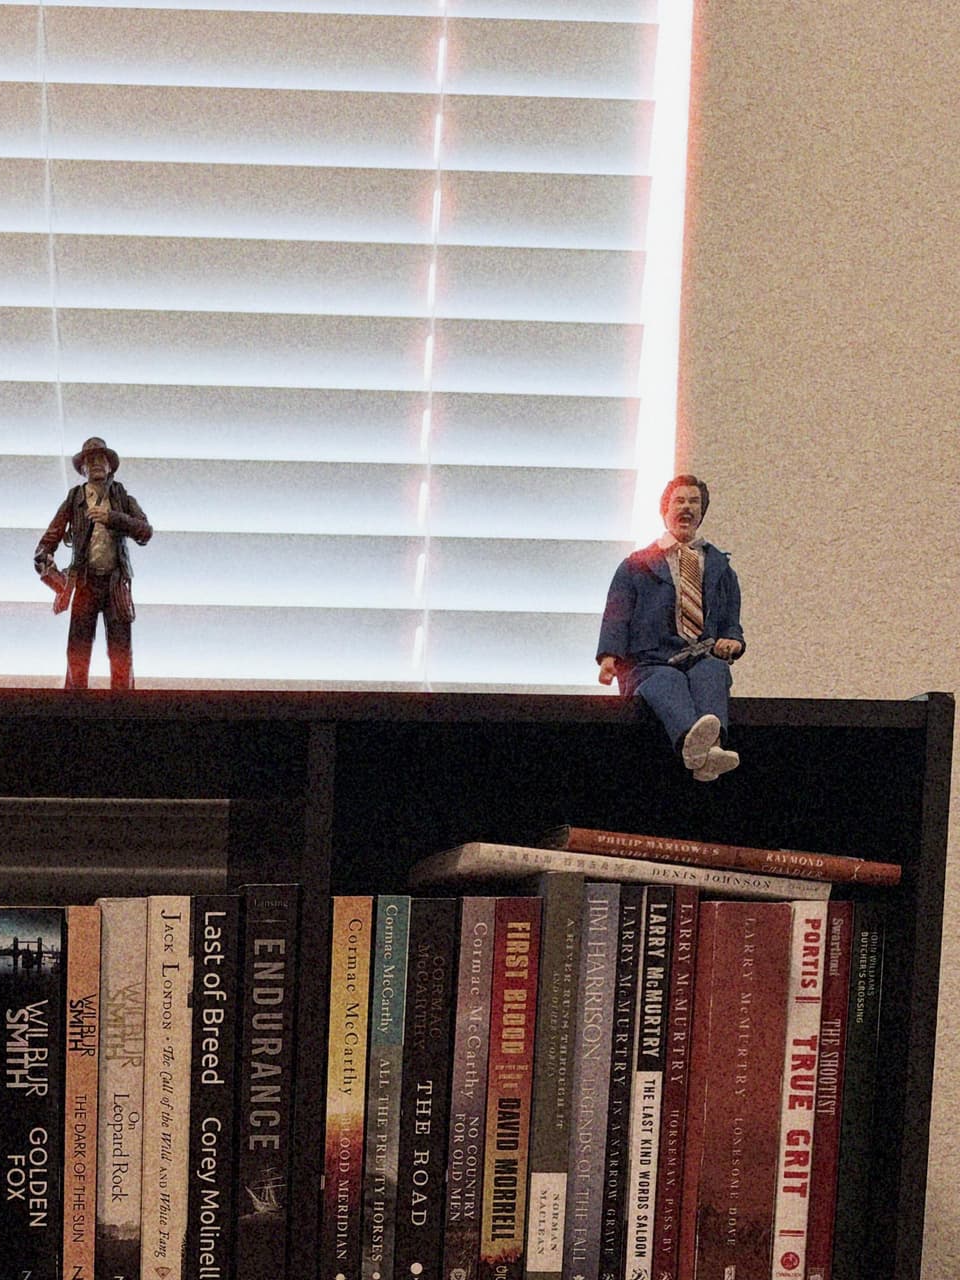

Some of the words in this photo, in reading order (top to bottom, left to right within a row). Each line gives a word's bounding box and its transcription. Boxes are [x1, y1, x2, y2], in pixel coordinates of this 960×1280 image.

[766, 854, 823, 868] RAYMOND
[204, 911, 226, 965] Last
[346, 919, 362, 992] Cormac
[505, 922, 530, 980] FIRST
[648, 904, 667, 959] LARRY
[802, 919, 821, 989] PORTIS
[203, 975, 226, 1001] of
[642, 967, 663, 1057] McMURTRY
[201, 1009, 225, 1084] Breed
[249, 938, 286, 1150] ENDURANCE
[339, 1003, 359, 1096] McCarthy
[502, 989, 527, 1053] BLOOD
[644, 1080, 656, 1100] THE
[789, 1035, 818, 1111] TRUE
[415, 1081, 433, 1135] THE
[497, 1099, 520, 1150] DAVID
[643, 1106, 653, 1133] LAST
[7, 1155, 25, 1200] FOX
[29, 1127, 47, 1227] GOLDEN
[197, 1117, 221, 1183] Corey
[641, 1140, 652, 1165] KIND
[782, 1130, 811, 1197] GRIT
[411, 1150, 430, 1226] ROAD
[492, 1160, 518, 1241] MORRELL
[639, 1172, 650, 1208] WORDS
[635, 1215, 648, 1257] SALOON
